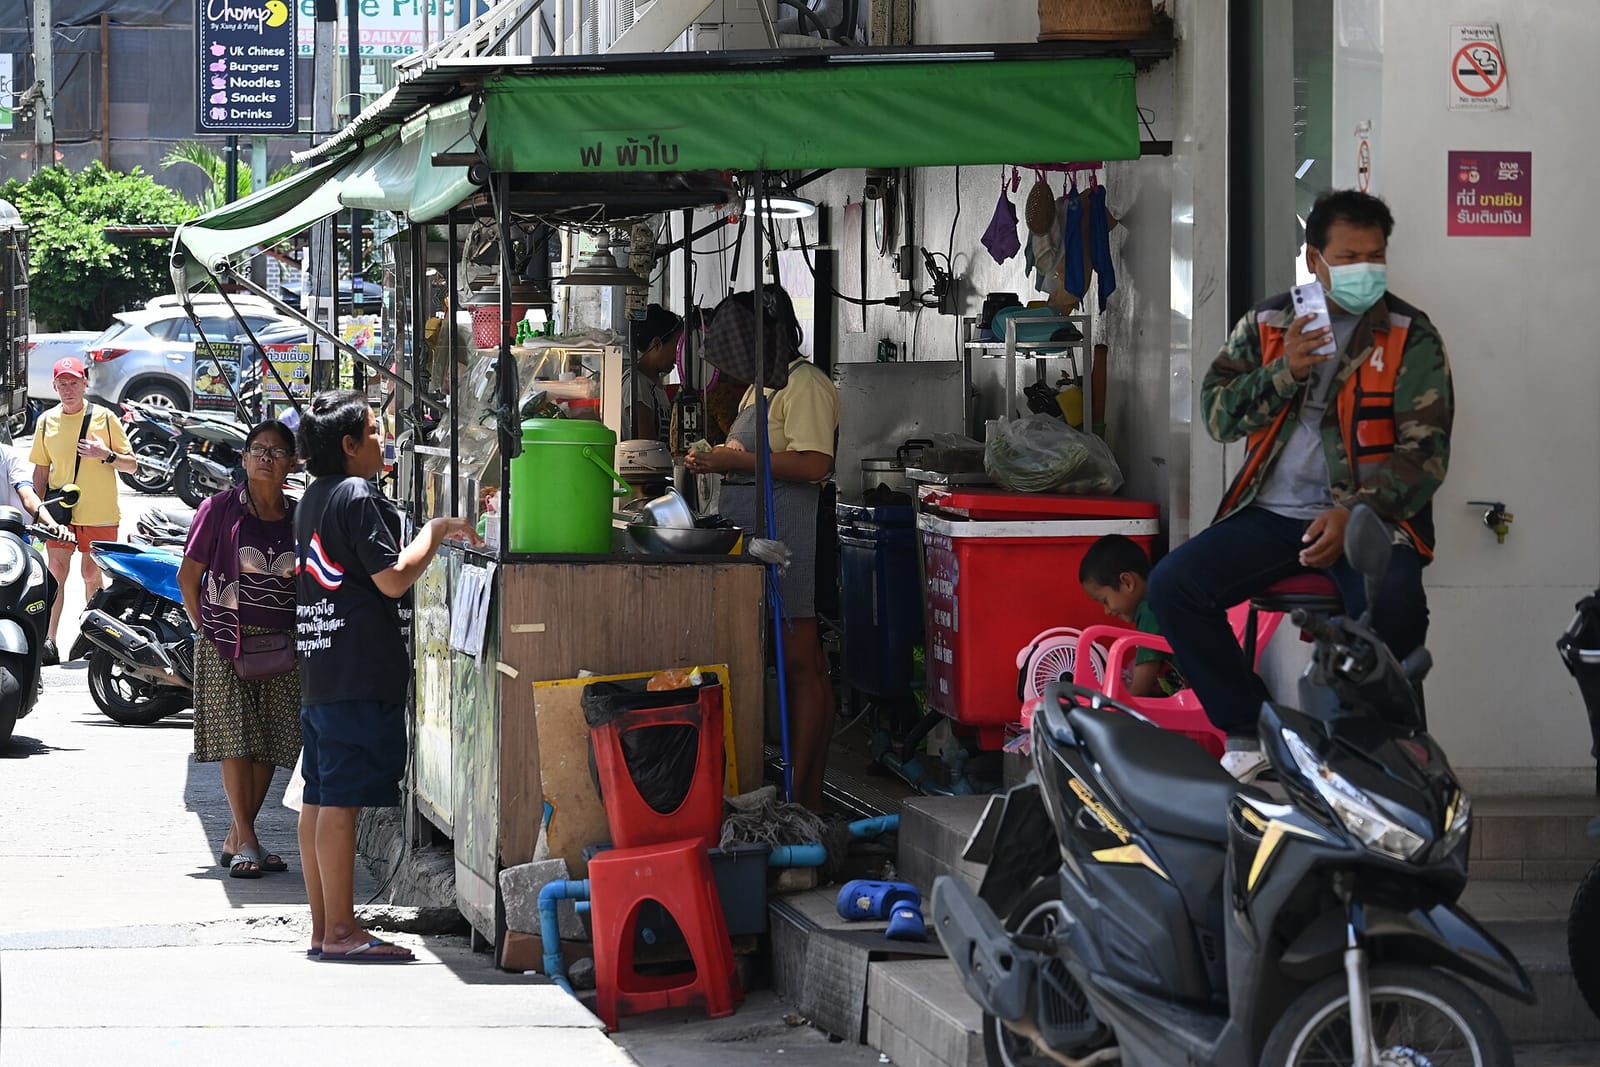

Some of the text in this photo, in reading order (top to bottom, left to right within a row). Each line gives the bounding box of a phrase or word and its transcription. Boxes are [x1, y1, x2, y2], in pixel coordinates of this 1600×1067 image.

[207, 0, 271, 35] Chomp
[230, 46, 285, 56] UK Chinese
[230, 62, 279, 73] Burgers
[230, 77, 281, 88] Noodles
[231, 92, 277, 103] Snacks
[231, 109, 272, 119] Drinks
[1500, 161, 1519, 170] true
[1497, 169, 1520, 181] 5G
[1456, 188, 1523, 207] ที่นี่ ขายซิม
[1456, 209, 1522, 225] รับเติมเงิน
[1370, 345, 1384, 373] 4
